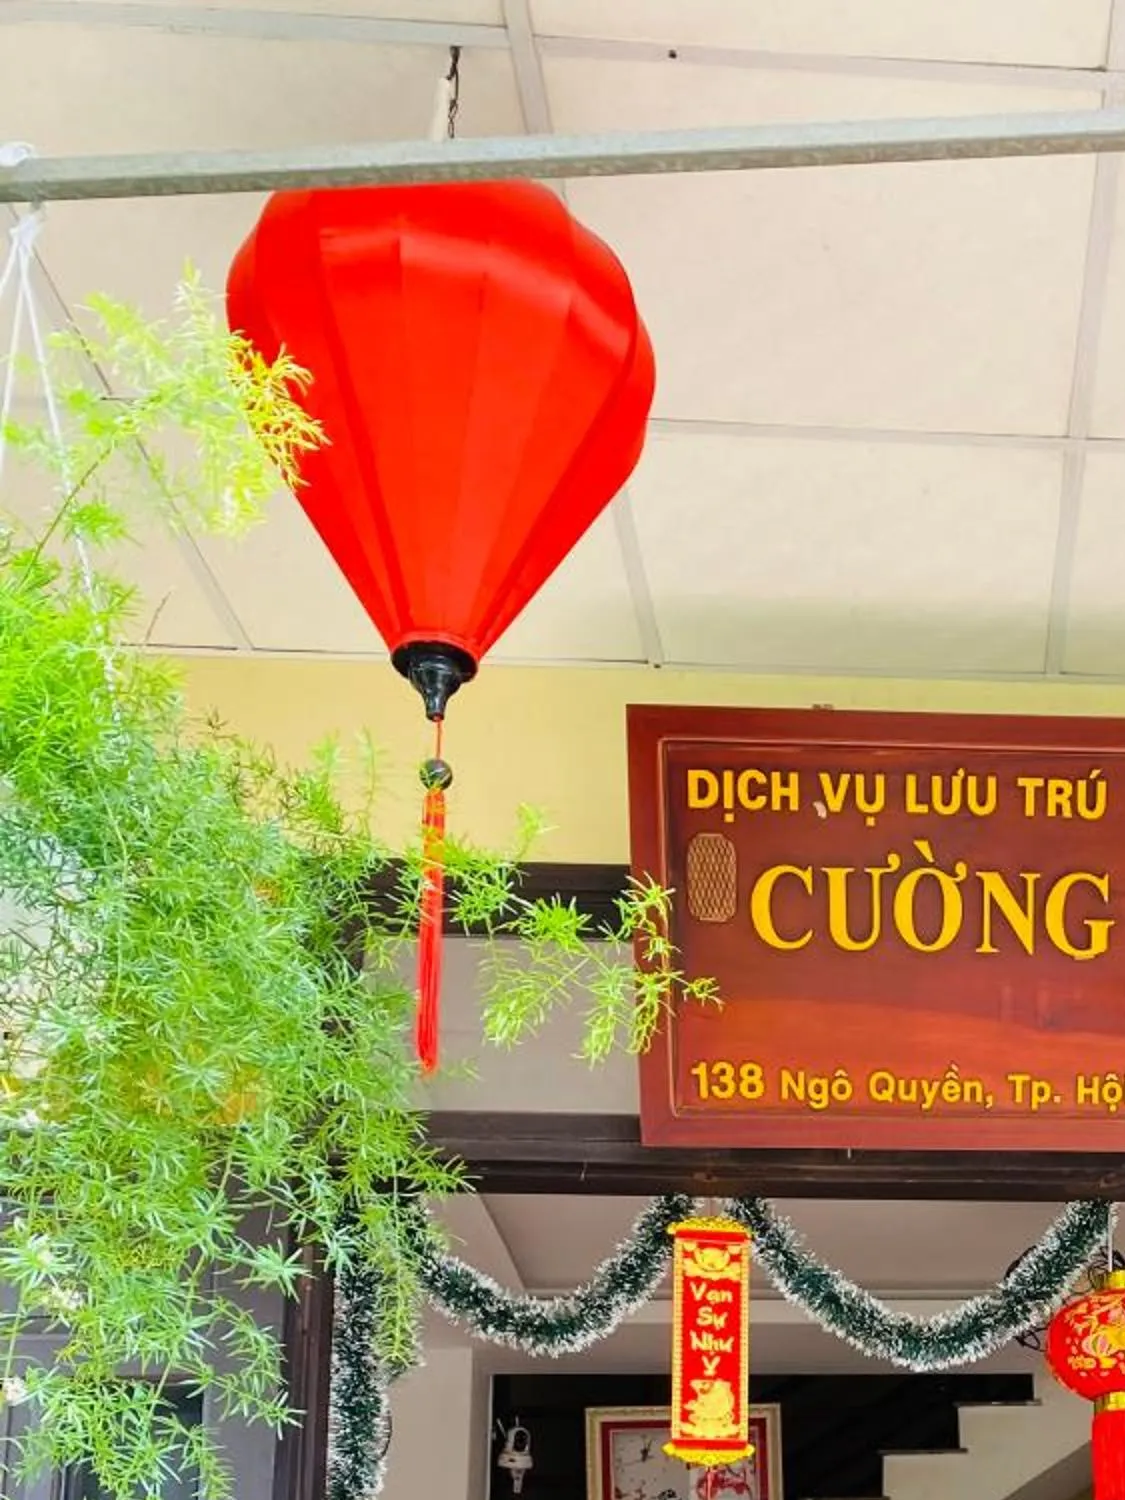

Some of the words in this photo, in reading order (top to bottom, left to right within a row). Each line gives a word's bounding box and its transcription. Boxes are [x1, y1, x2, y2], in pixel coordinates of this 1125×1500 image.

[687, 770, 800, 823] DỊCH
[819, 773, 886, 827] VỤ
[905, 769, 997, 816] LƯU
[1017, 770, 1108, 820] TRÚ
[751, 840, 1115, 960] CƯỜNG
[692, 1063, 765, 1100] 138
[781, 1070, 853, 1110] Ngô
[868, 1064, 993, 1110] Quyền,
[1007, 1074, 1062, 1111] Tp.
